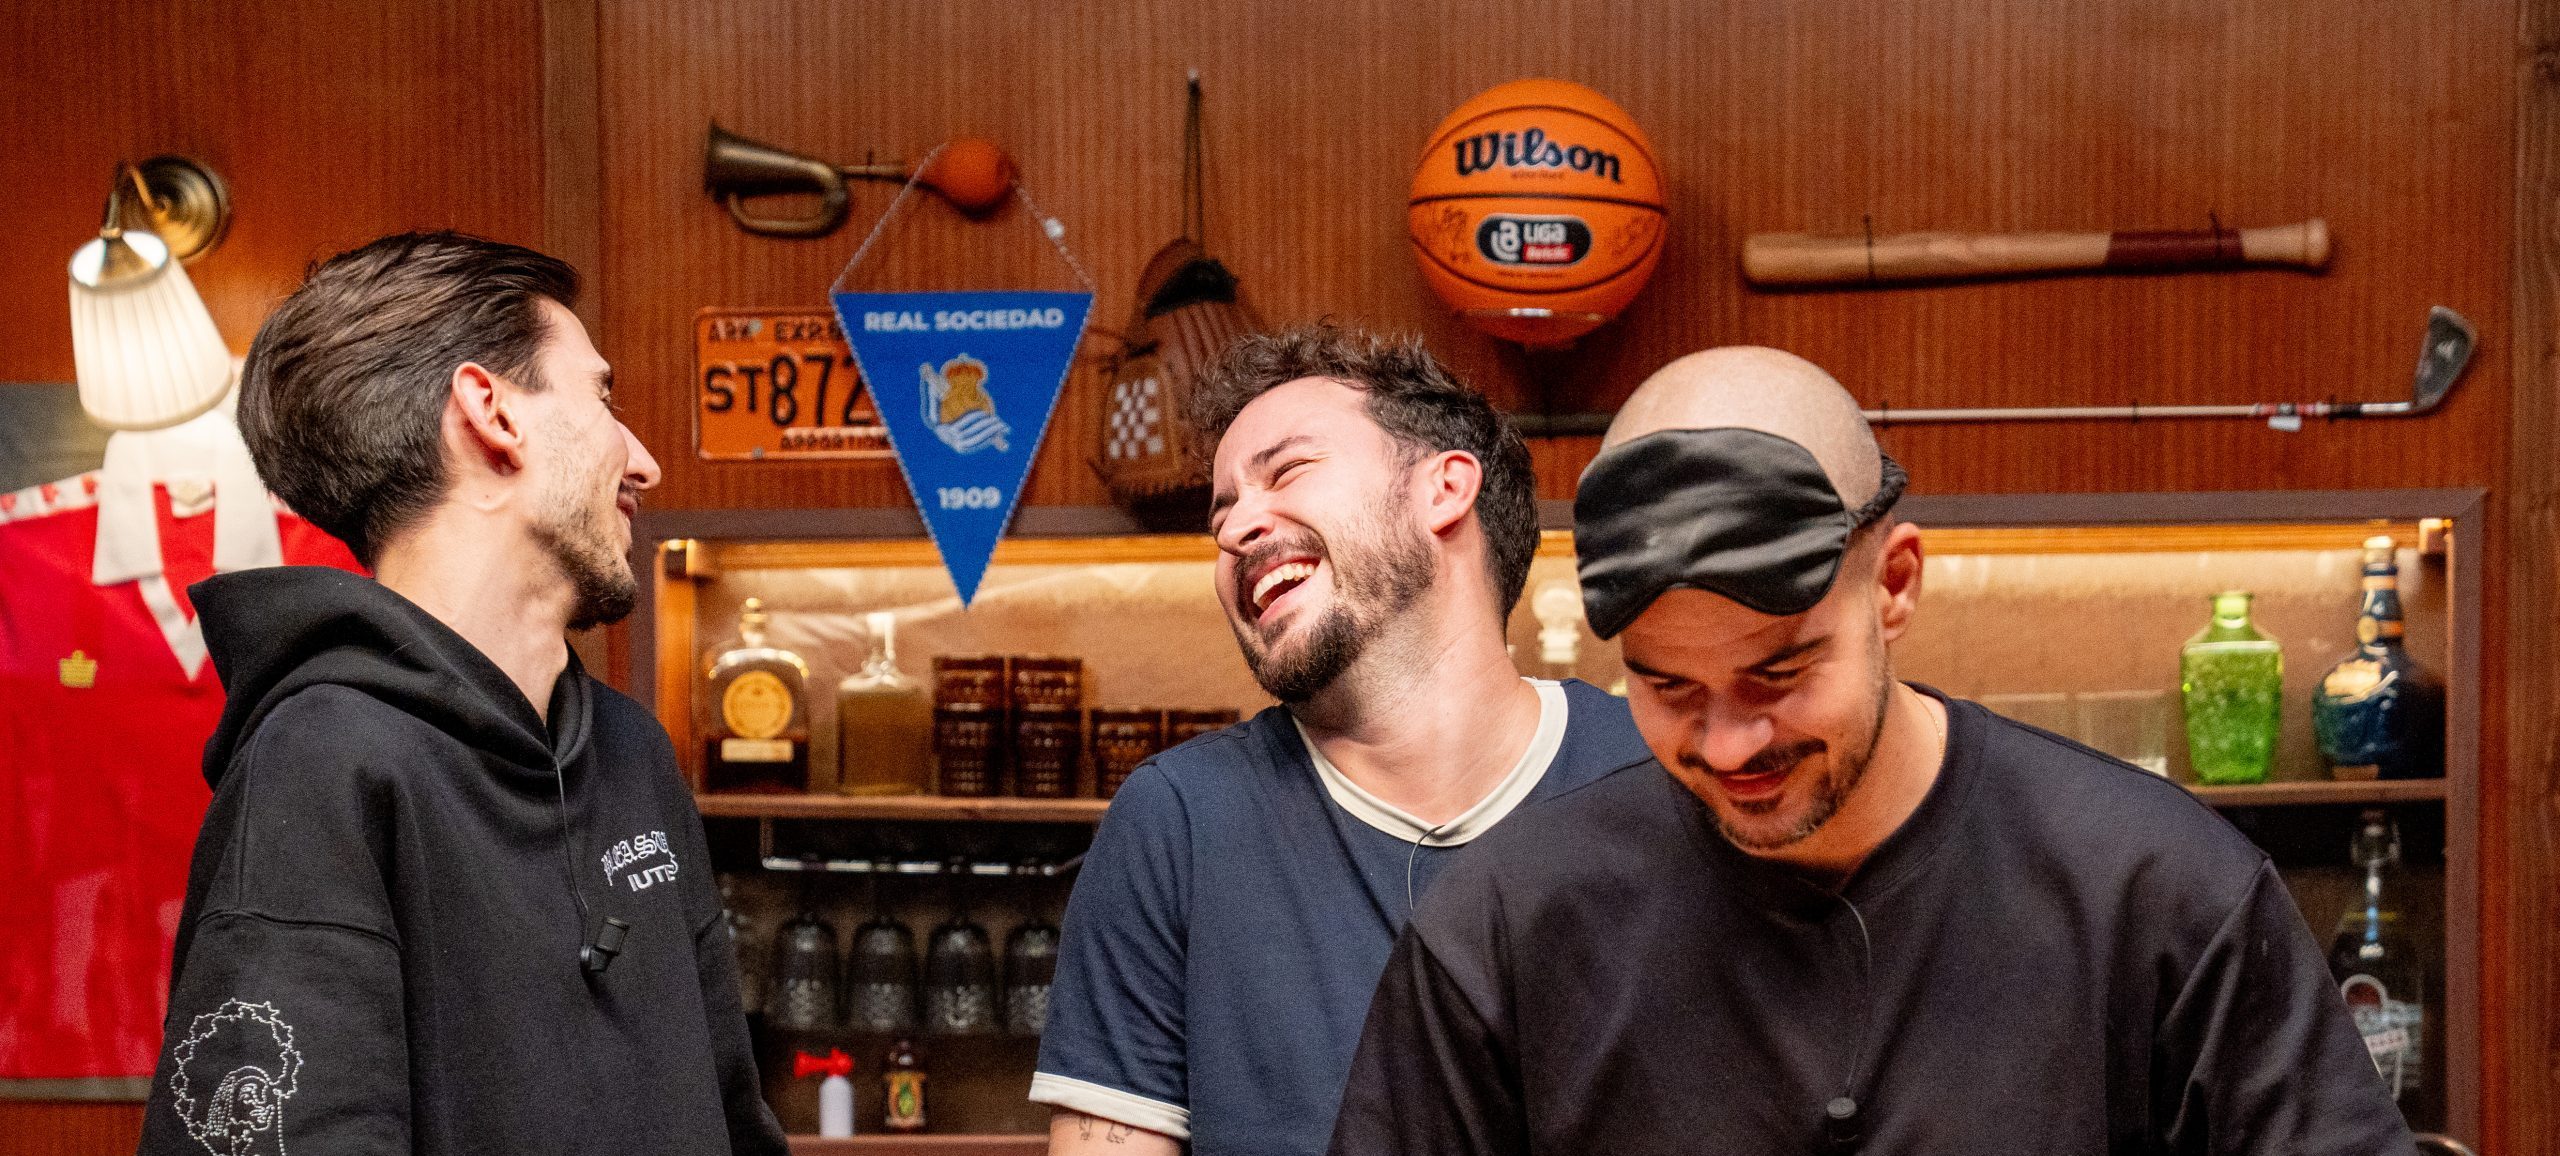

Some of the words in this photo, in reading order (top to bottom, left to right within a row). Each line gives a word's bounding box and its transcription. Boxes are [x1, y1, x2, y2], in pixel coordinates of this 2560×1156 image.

[1454, 128, 1622, 184] Wilson
[864, 312, 929, 331] REAL
[934, 308, 1065, 331] SOCIEDAD
[936, 487, 1001, 509] 1909
